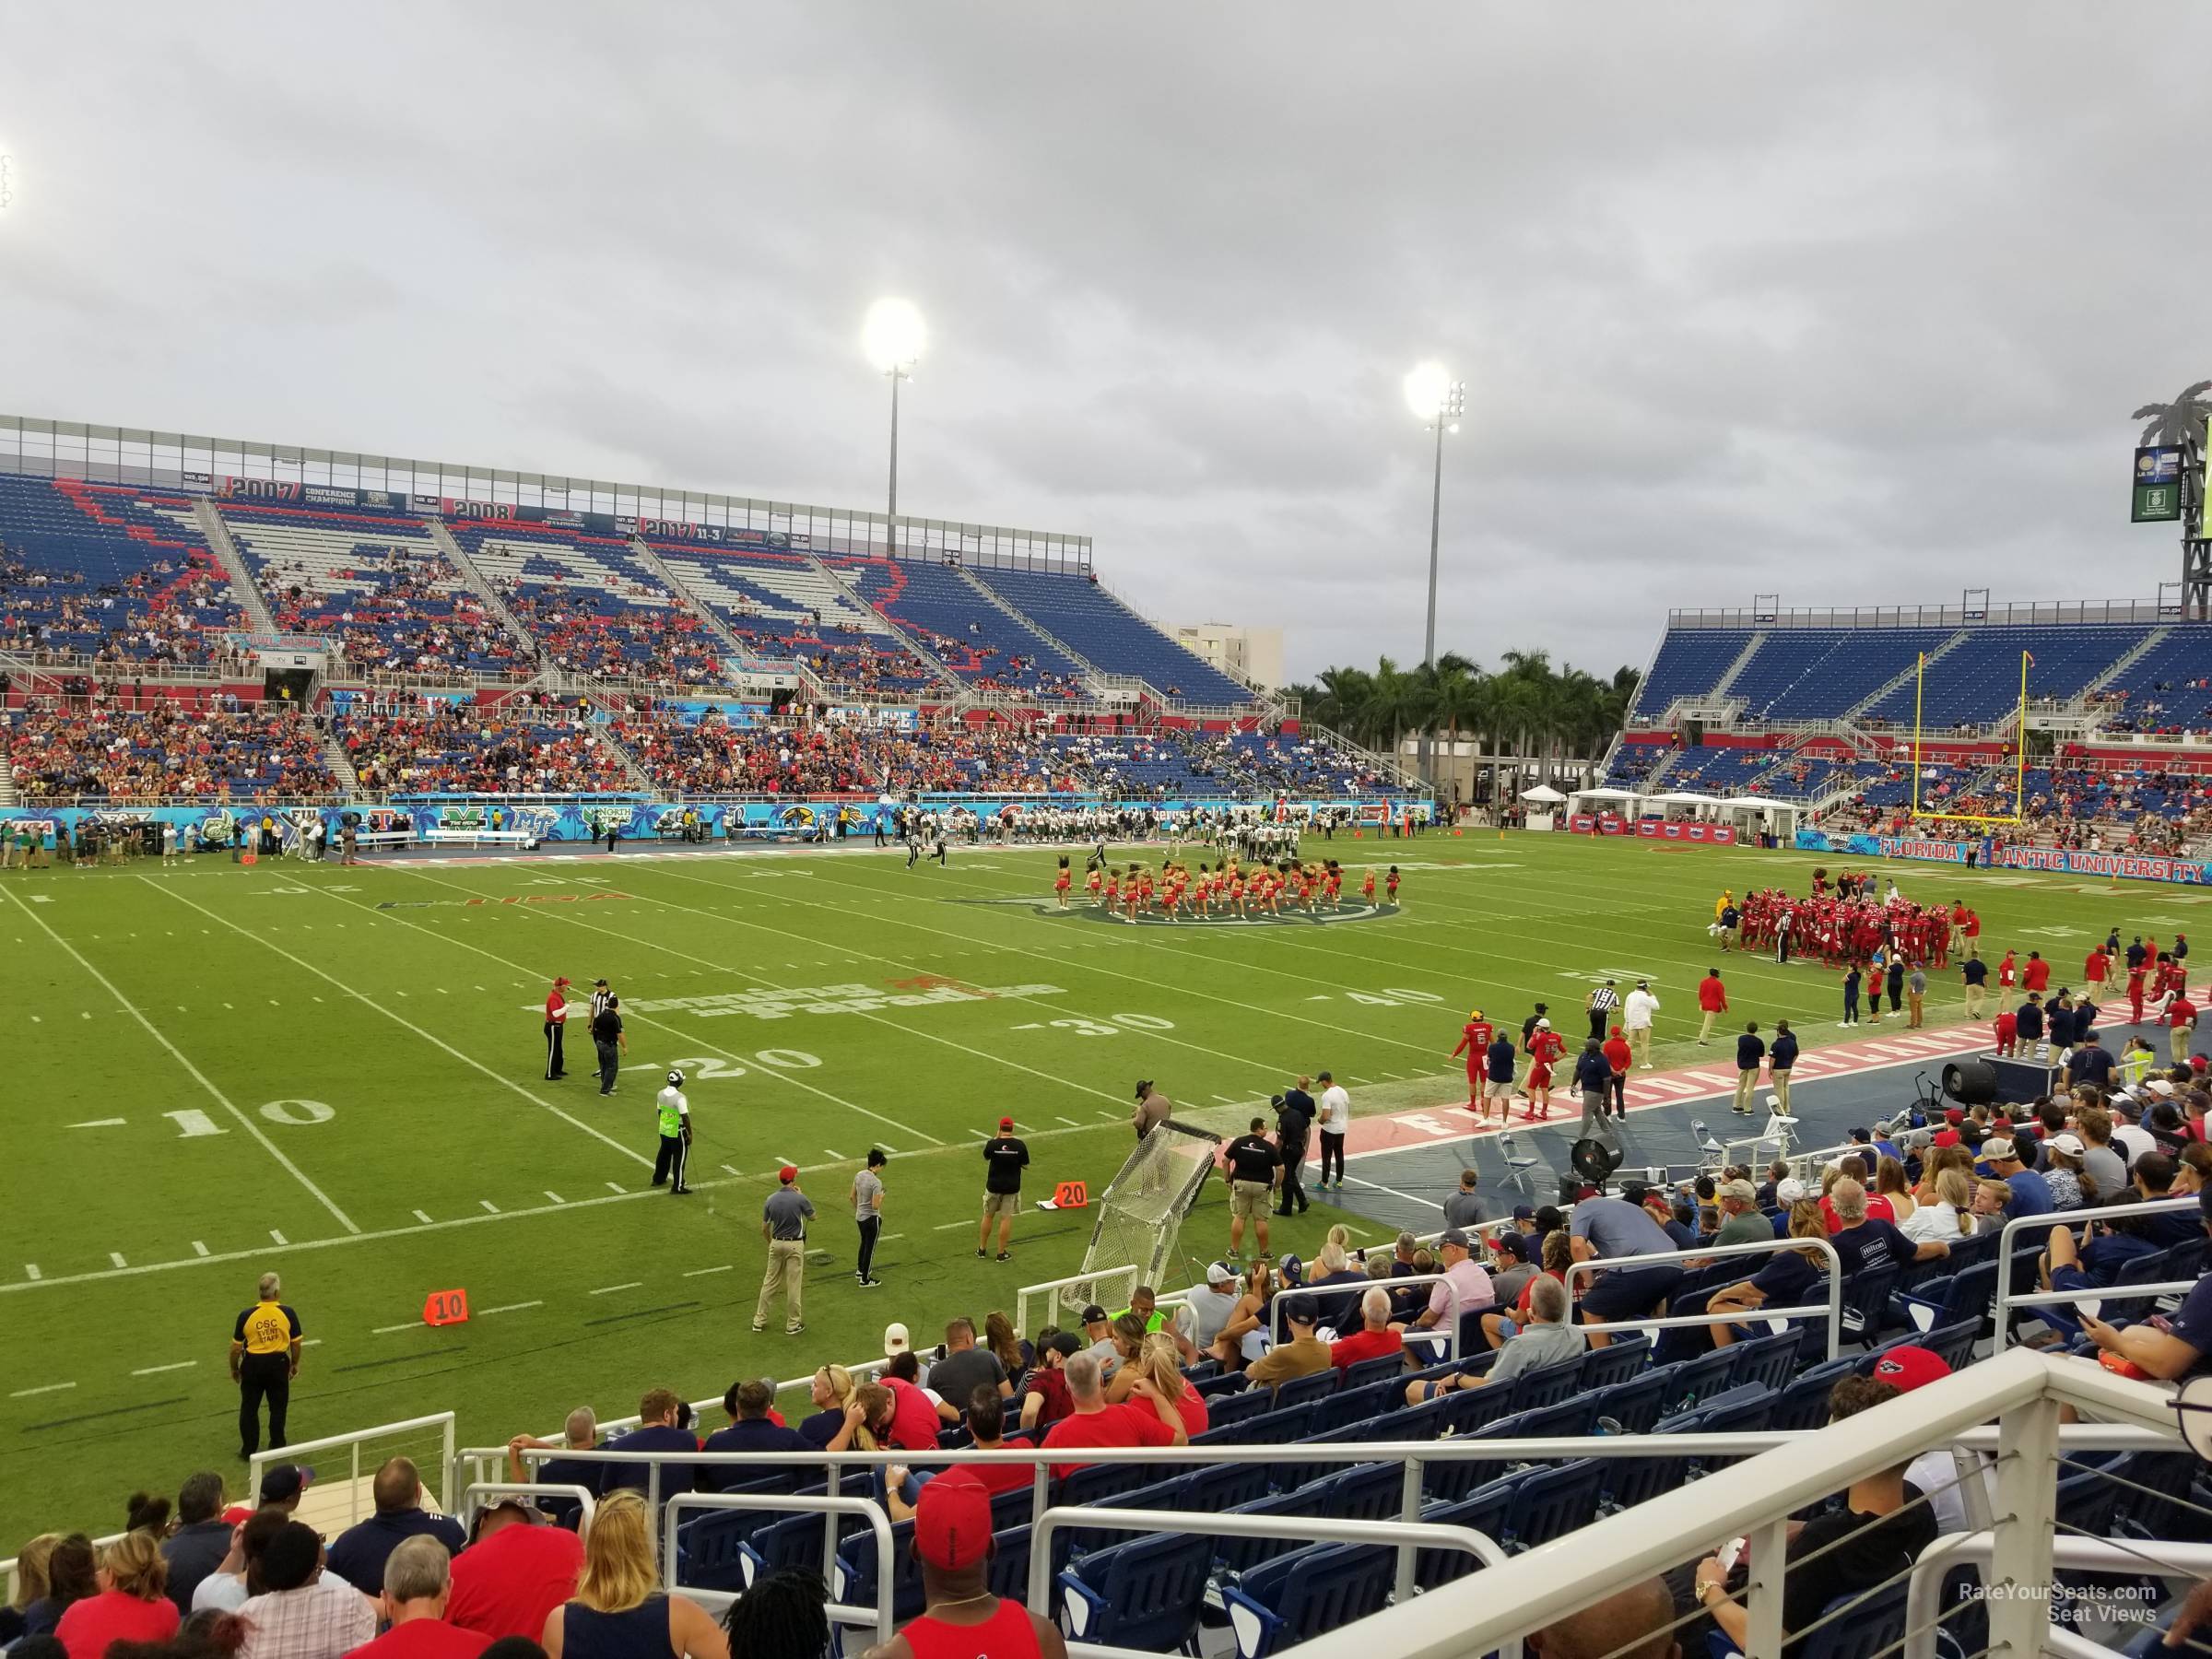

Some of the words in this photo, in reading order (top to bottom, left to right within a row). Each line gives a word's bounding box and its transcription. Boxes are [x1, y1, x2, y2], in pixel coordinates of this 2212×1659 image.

[231, 477, 295, 499] 2007
[305, 488, 356, 499] CONFERENCE
[305, 496, 356, 506] CHAMPIONS
[454, 500, 510, 519] 2008
[645, 520, 692, 538] 2017
[697, 527, 720, 541] 11-3
[599, 807, 630, 816] NORTH
[1880, 839, 1958, 860] FLORIDA
[2070, 853, 2206, 882] UNIVERSITY
[1345, 988, 1444, 1006] 40
[1049, 1013, 1175, 1036] 30
[669, 1049, 823, 1079] 20
[161, 1100, 335, 1137] 10
[1062, 1185, 1085, 1205] 20
[1863, 1241, 1885, 1255] Hilton
[435, 1294, 462, 1321] 10
[256, 1319, 277, 1330] CSC
[258, 1328, 279, 1336] EVENT
[259, 1335, 280, 1343] STAFF
